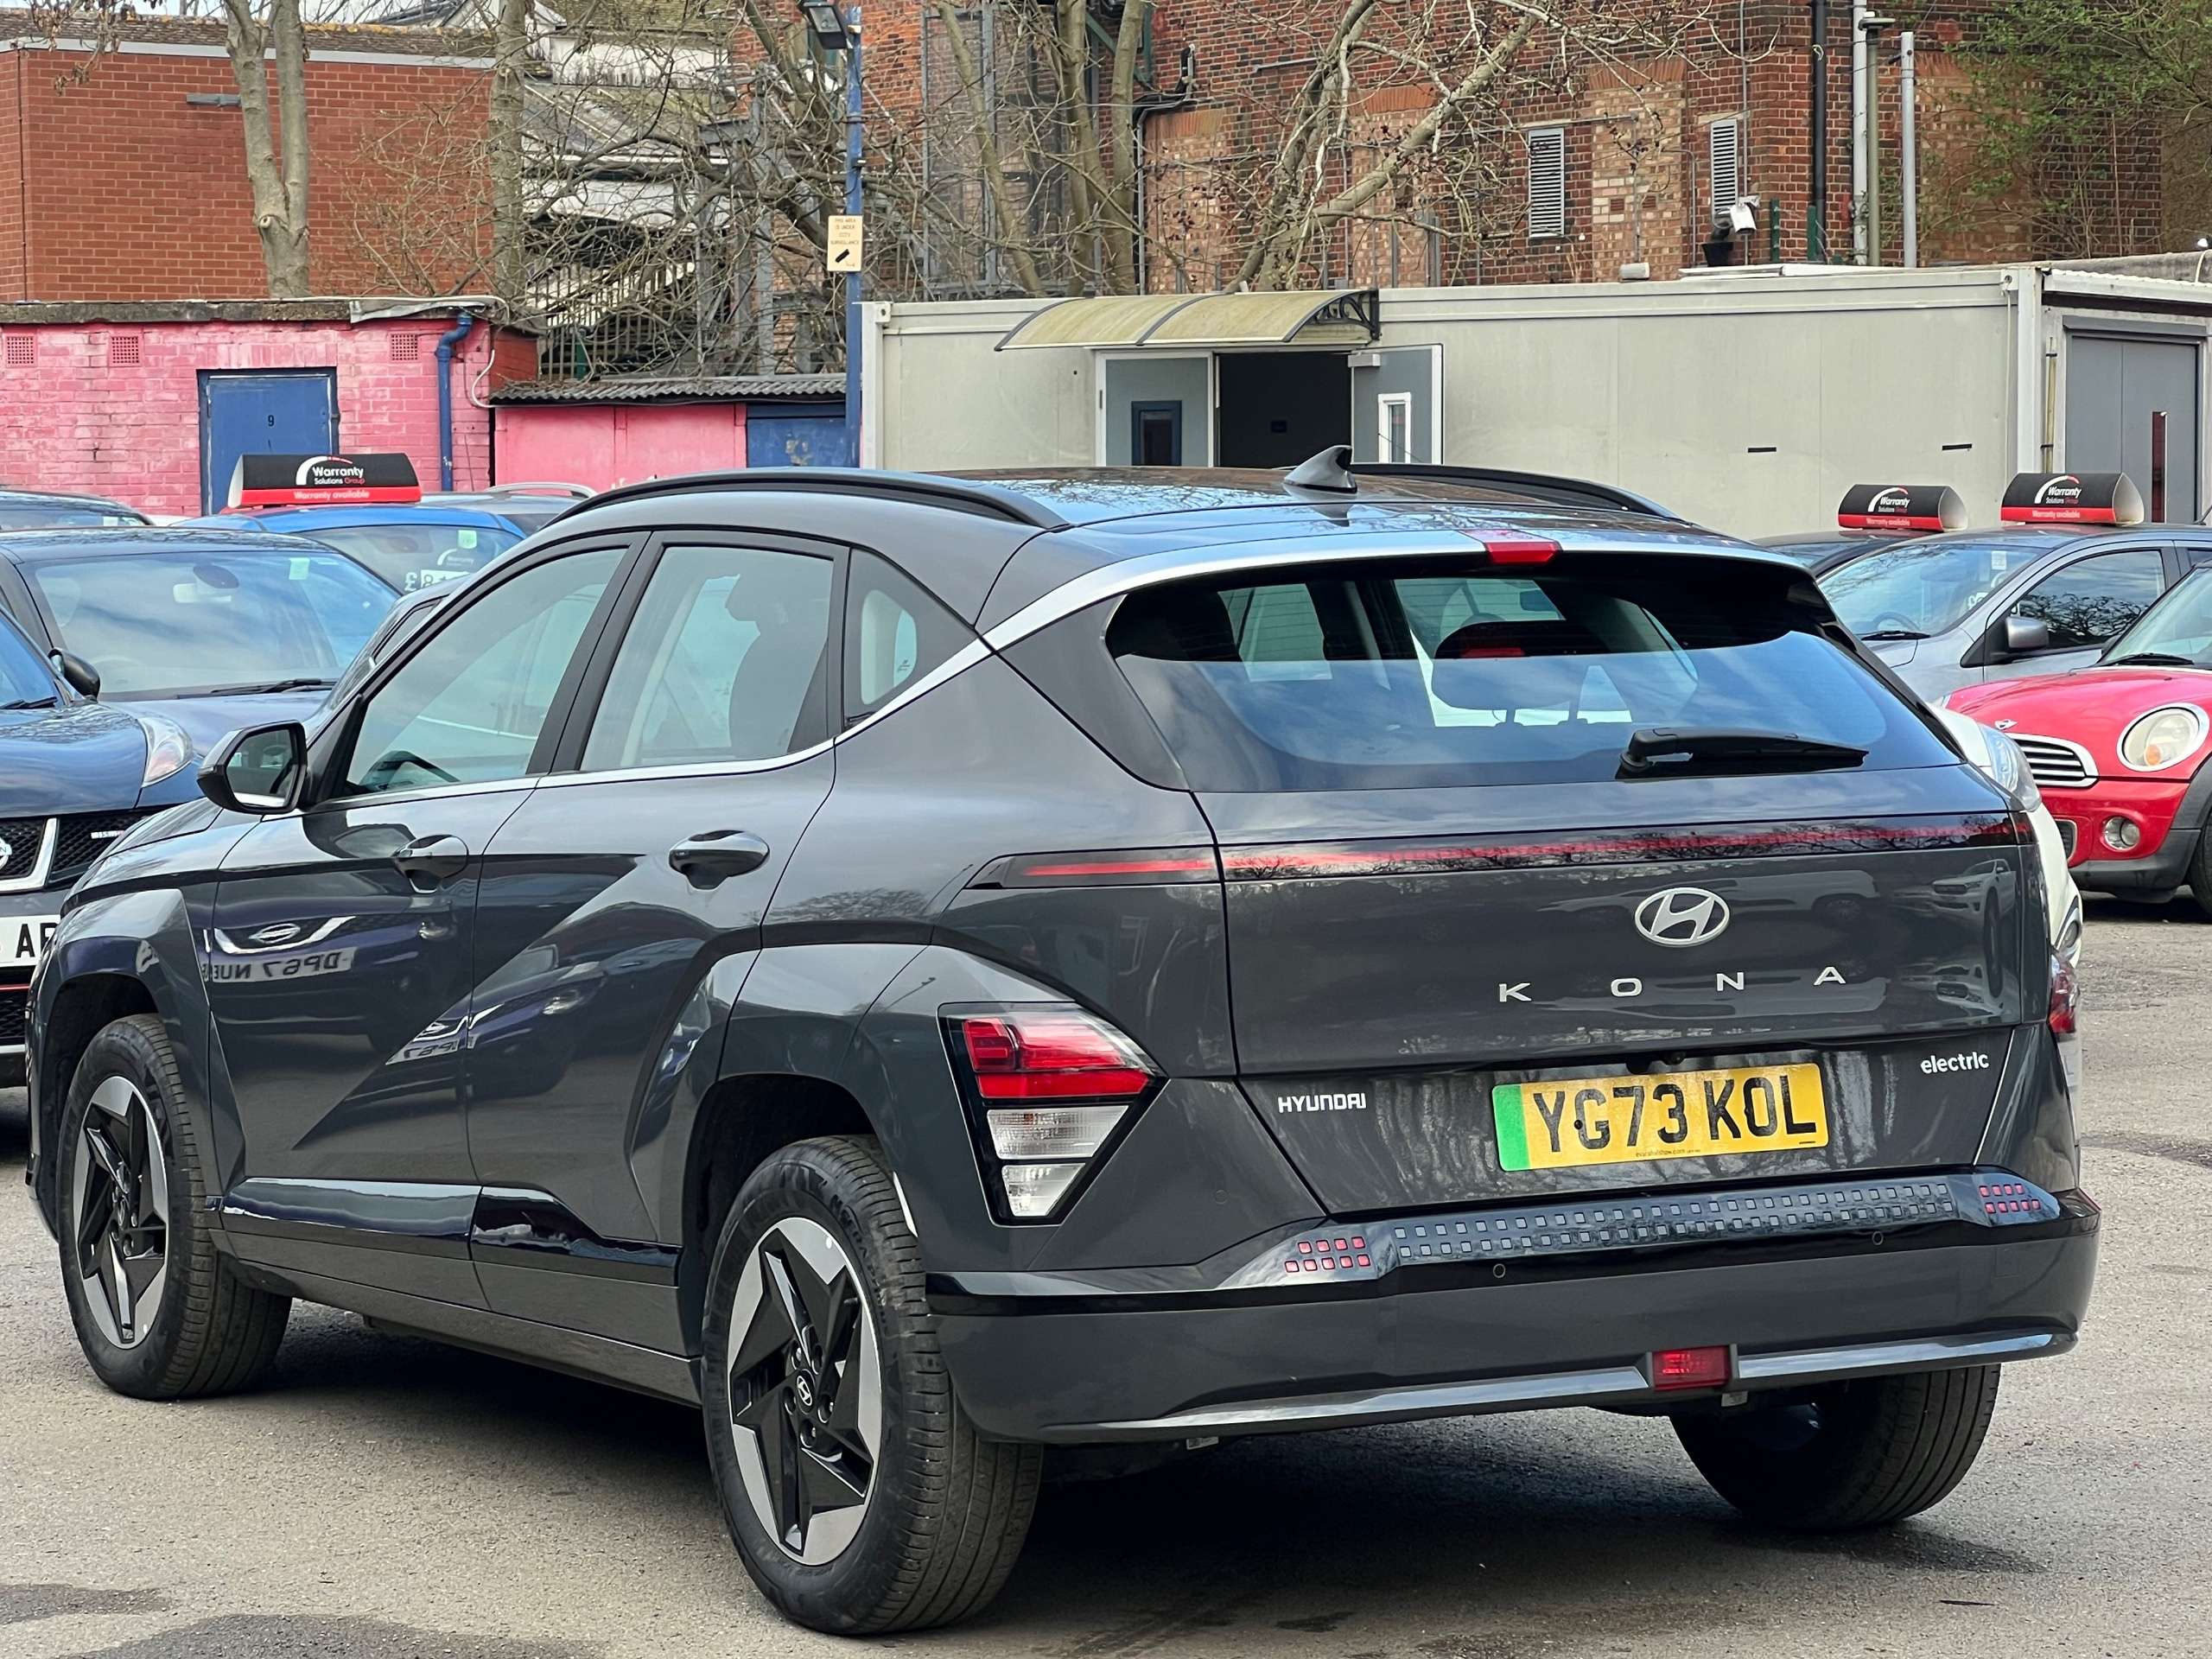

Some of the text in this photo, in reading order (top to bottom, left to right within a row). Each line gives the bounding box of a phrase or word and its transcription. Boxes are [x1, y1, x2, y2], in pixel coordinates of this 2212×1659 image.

[268, 415, 275, 427] 9
[312, 467, 364, 478] Warranty
[294, 489, 370, 499] Warranty available
[2048, 486, 2082, 499] Warranty
[1880, 496, 1910, 508] Warranty
[1498, 966, 1847, 1002] KONA
[1920, 1052, 1989, 1073] electric
[1277, 1093, 1366, 1113] HYUNDAI
[1533, 1075, 1818, 1153] YG73 KOL
